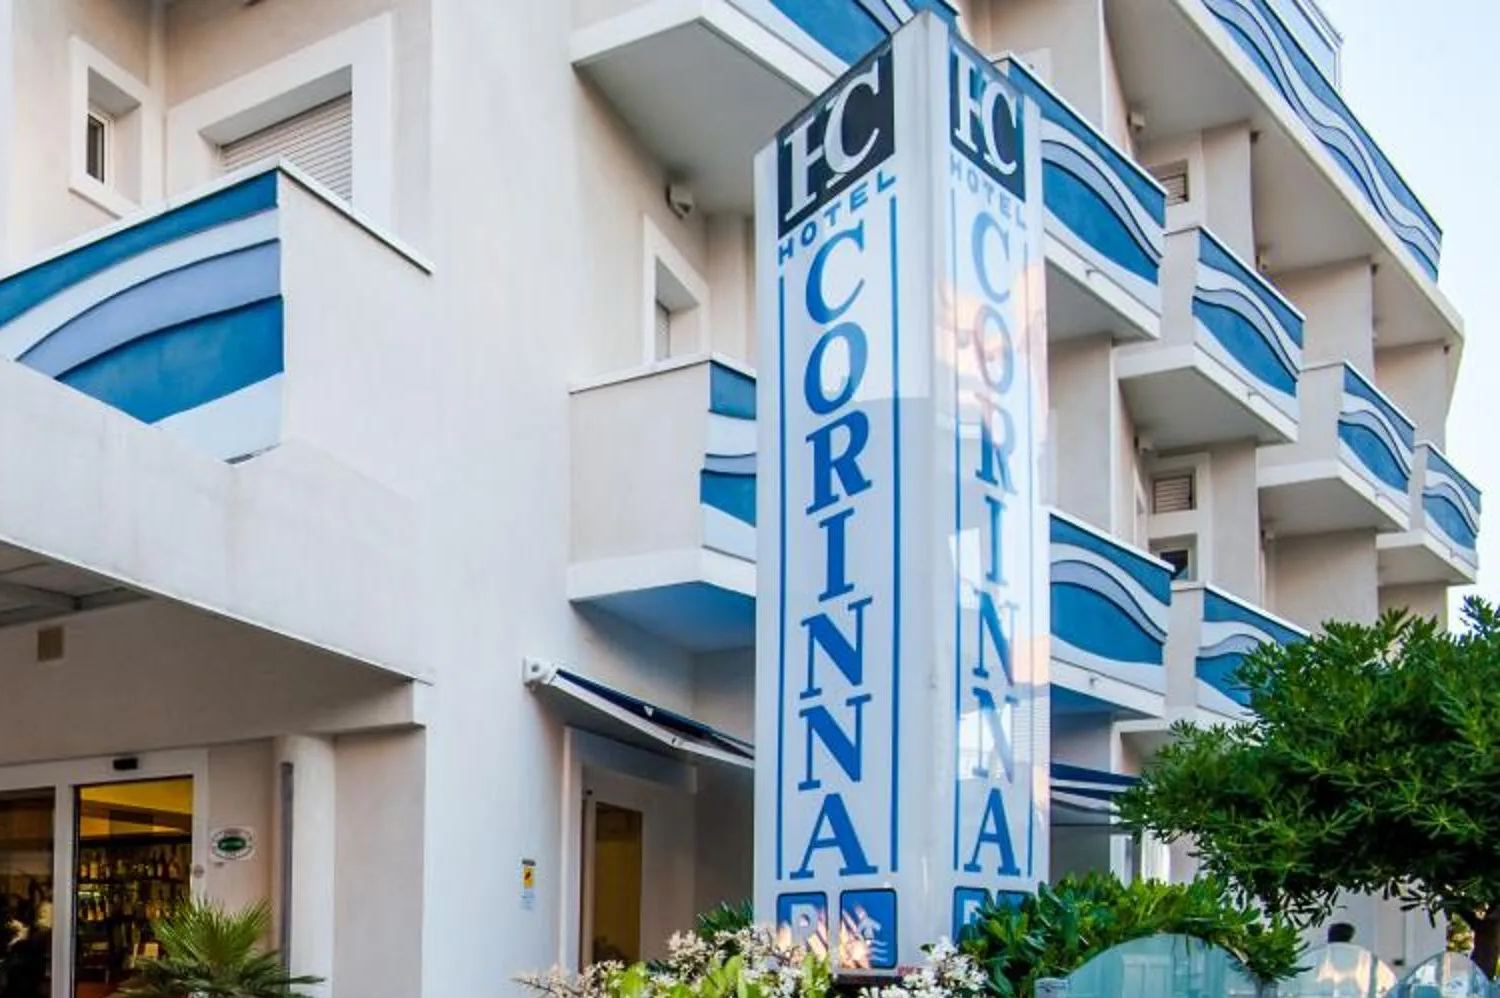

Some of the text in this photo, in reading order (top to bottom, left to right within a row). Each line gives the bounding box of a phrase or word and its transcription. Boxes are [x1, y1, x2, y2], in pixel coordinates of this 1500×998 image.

[778, 169, 897, 265] HOTEL
[950, 152, 1029, 231] HOTEL
[789, 218, 879, 880] CORINNA
[963, 211, 1021, 879] CORINNA
